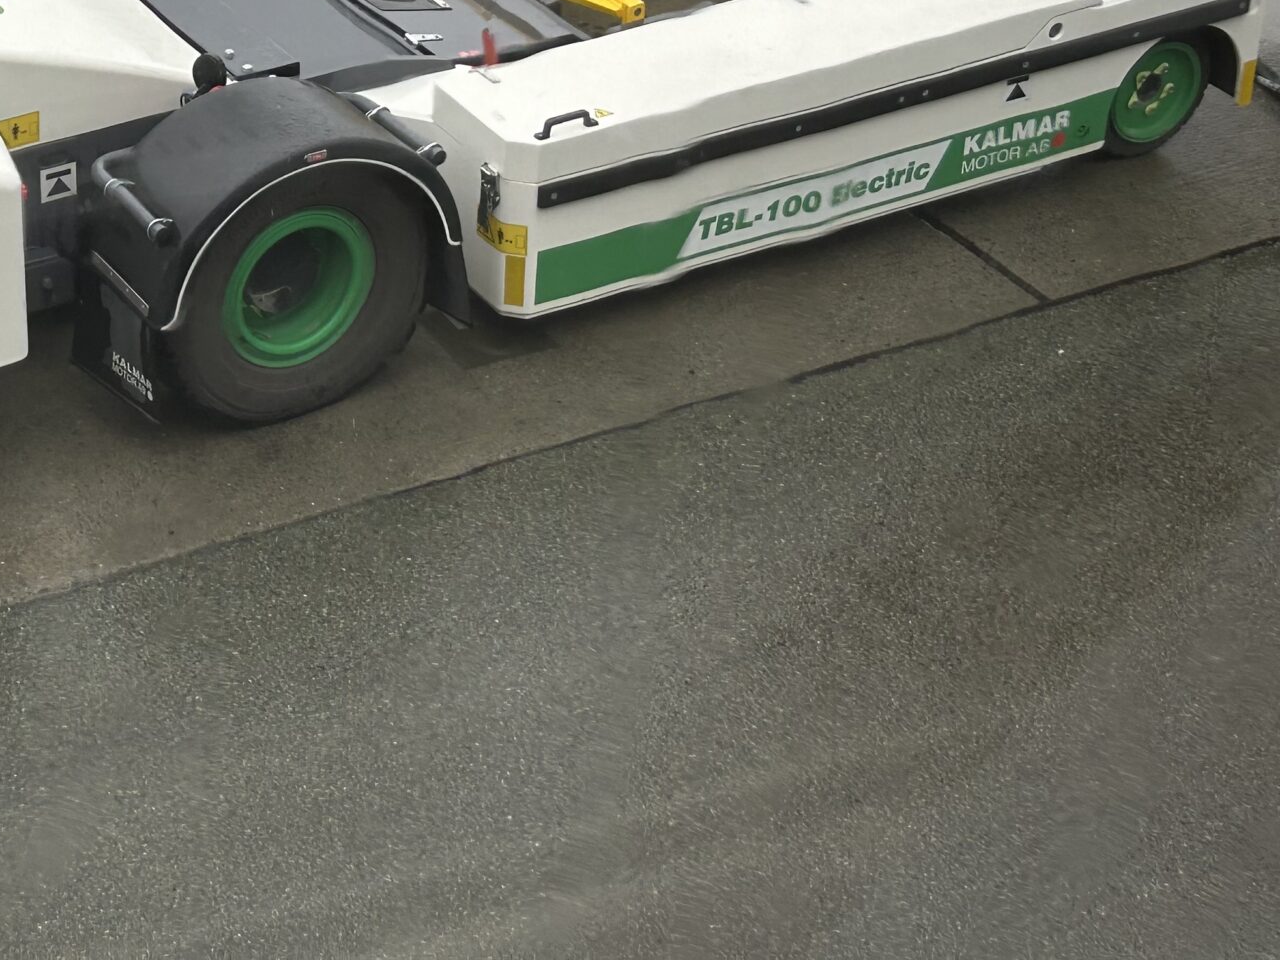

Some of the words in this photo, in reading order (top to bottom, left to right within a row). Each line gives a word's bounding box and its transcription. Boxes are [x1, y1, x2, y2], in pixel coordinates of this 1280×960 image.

[963, 110, 1070, 156] KALMAR
[960, 145, 1020, 175] MOTOR
[698, 190, 822, 240] TBL-100
[830, 160, 931, 208] Electric
[112, 351, 153, 392] KALMAR
